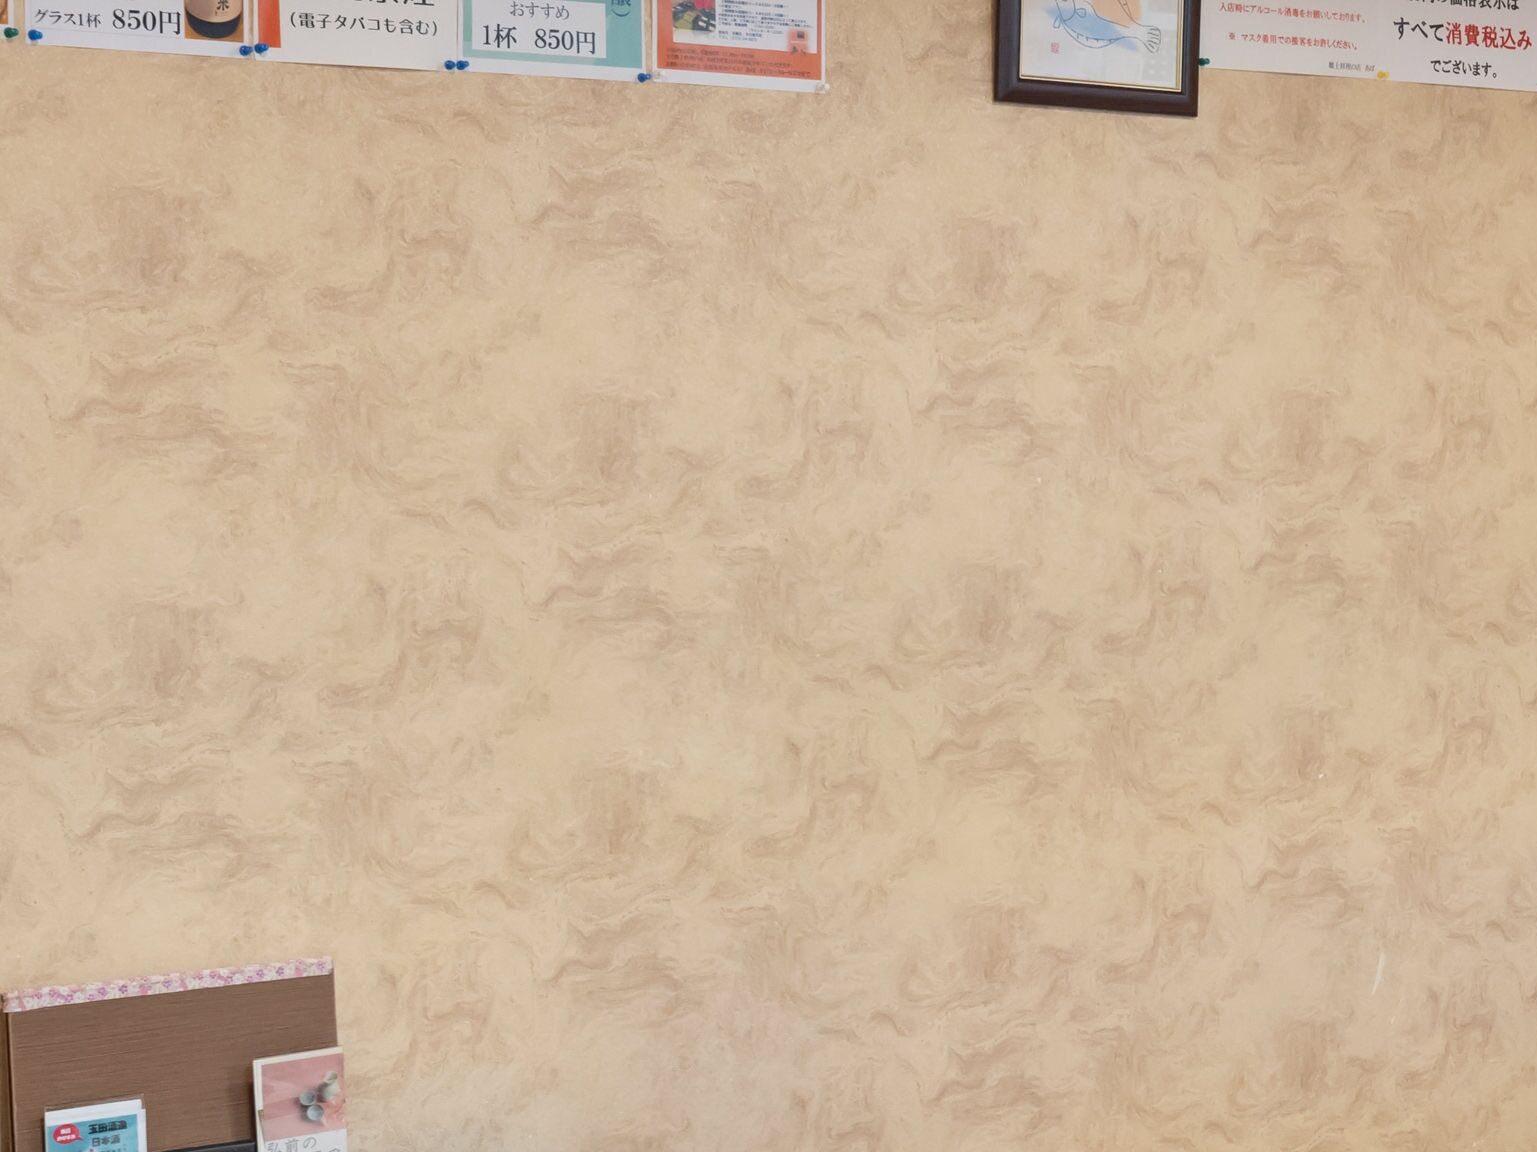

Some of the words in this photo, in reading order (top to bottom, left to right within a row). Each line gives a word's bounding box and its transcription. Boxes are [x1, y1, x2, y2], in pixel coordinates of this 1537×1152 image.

[33, 8, 101, 29] グラス1杯
[112, 7, 182, 36] 850円
[510, 0, 570, 20] おすすめ
[1219, 2, 1366, 23] 入店時にアルコール消毒をお願いしております。
[289, 11, 439, 38] （電子タバコも含む）
[1393, 16, 1533, 51] すべて消費税込み
[483, 23, 518, 49] 1杯
[534, 27, 596, 55] 850円
[1430, 59, 1498, 79] でございます。
